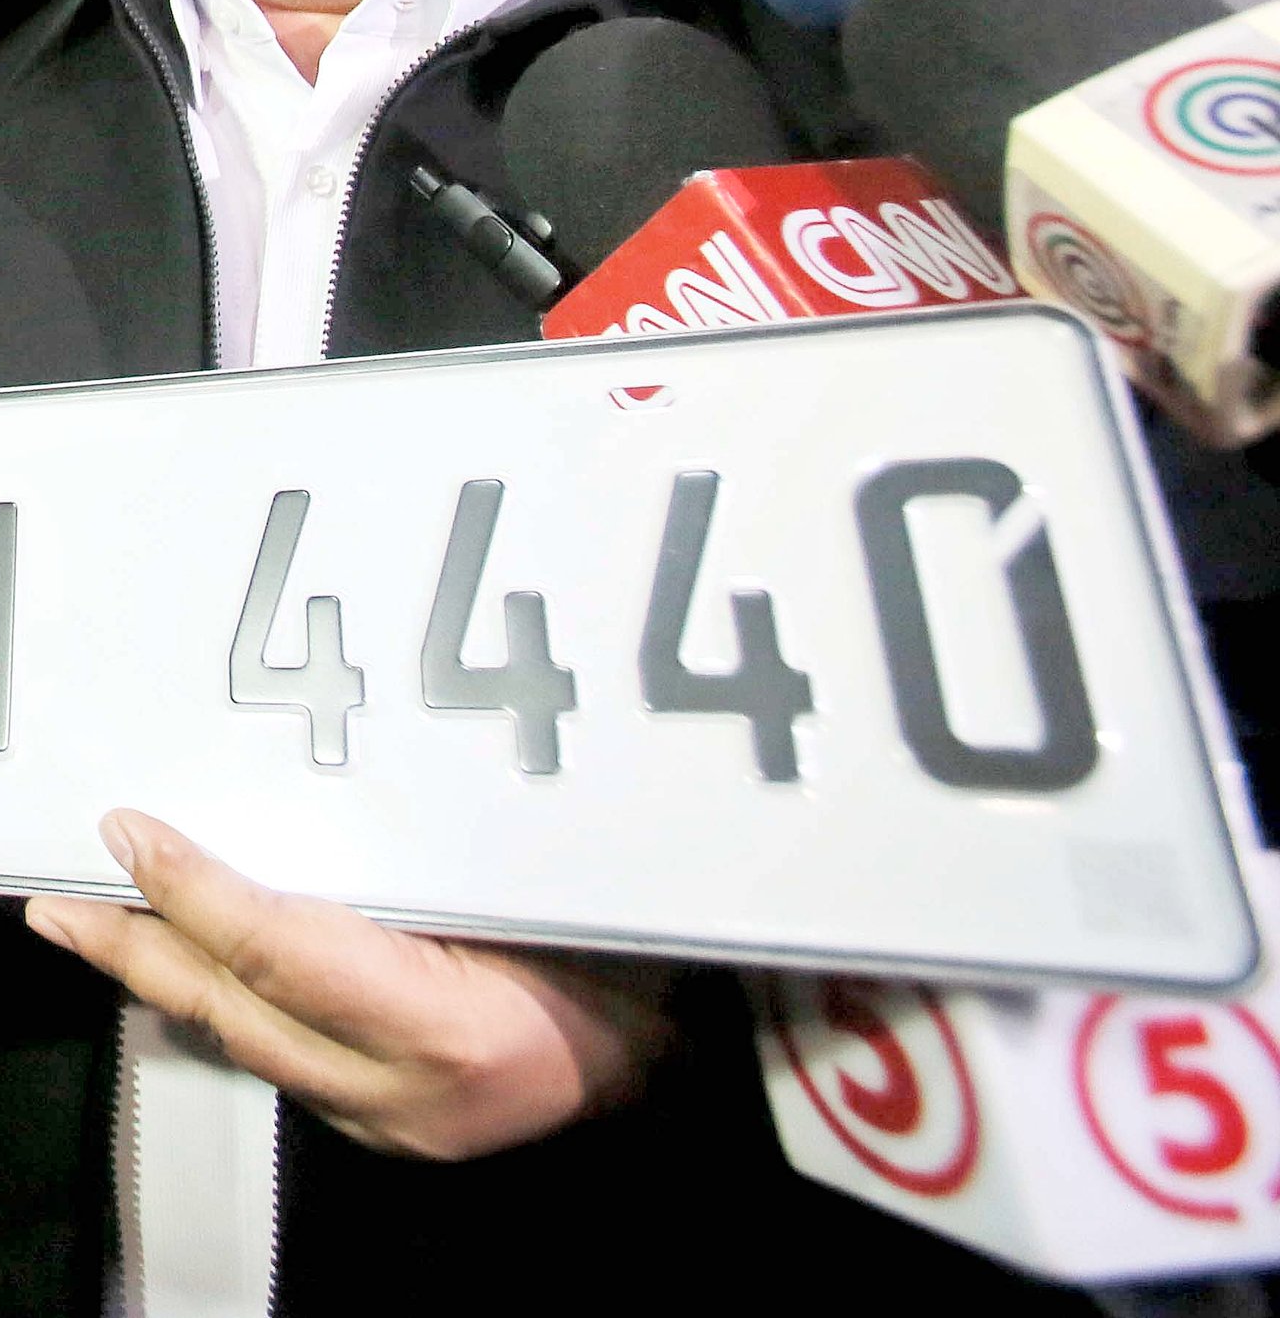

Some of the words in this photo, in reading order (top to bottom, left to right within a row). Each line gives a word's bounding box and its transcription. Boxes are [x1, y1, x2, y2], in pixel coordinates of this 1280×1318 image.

[780, 198, 1017, 309] CNN
[230, 456, 1099, 792] 4440
[1137, 1012, 1248, 1176] 5
